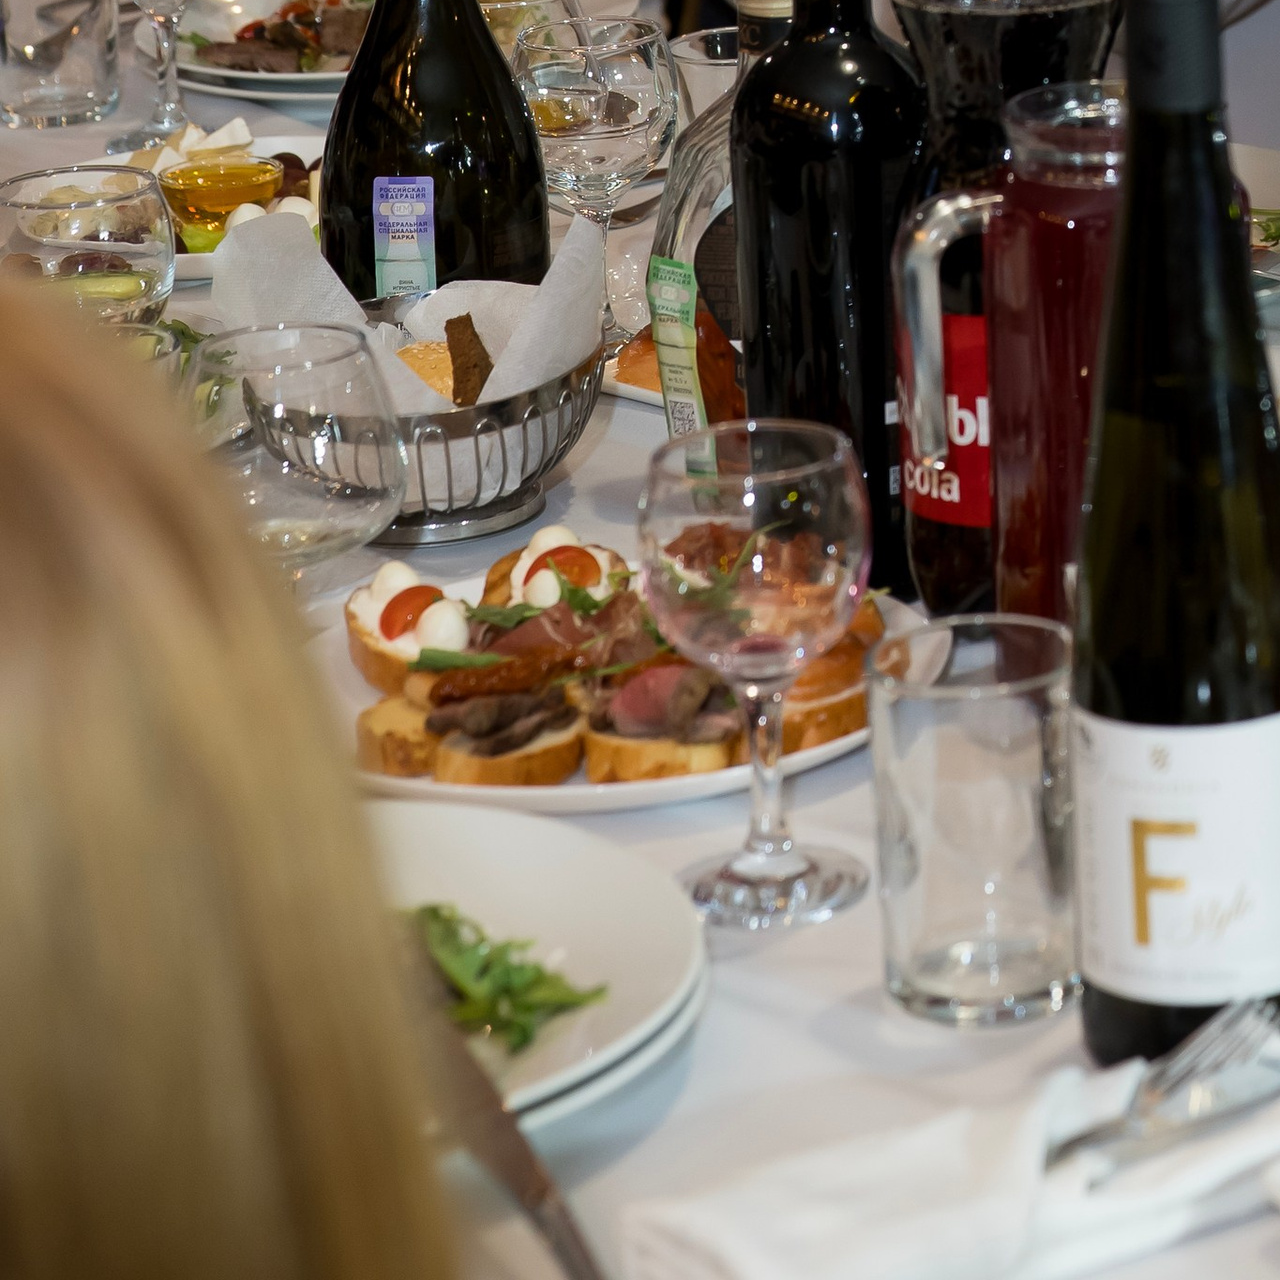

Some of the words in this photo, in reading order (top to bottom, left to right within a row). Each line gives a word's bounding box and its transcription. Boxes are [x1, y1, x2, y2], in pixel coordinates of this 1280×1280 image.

[379, 185, 426, 193] РОССИЙСКАЯ
[904, 459, 961, 503] cola
[1131, 818, 1198, 946] F
